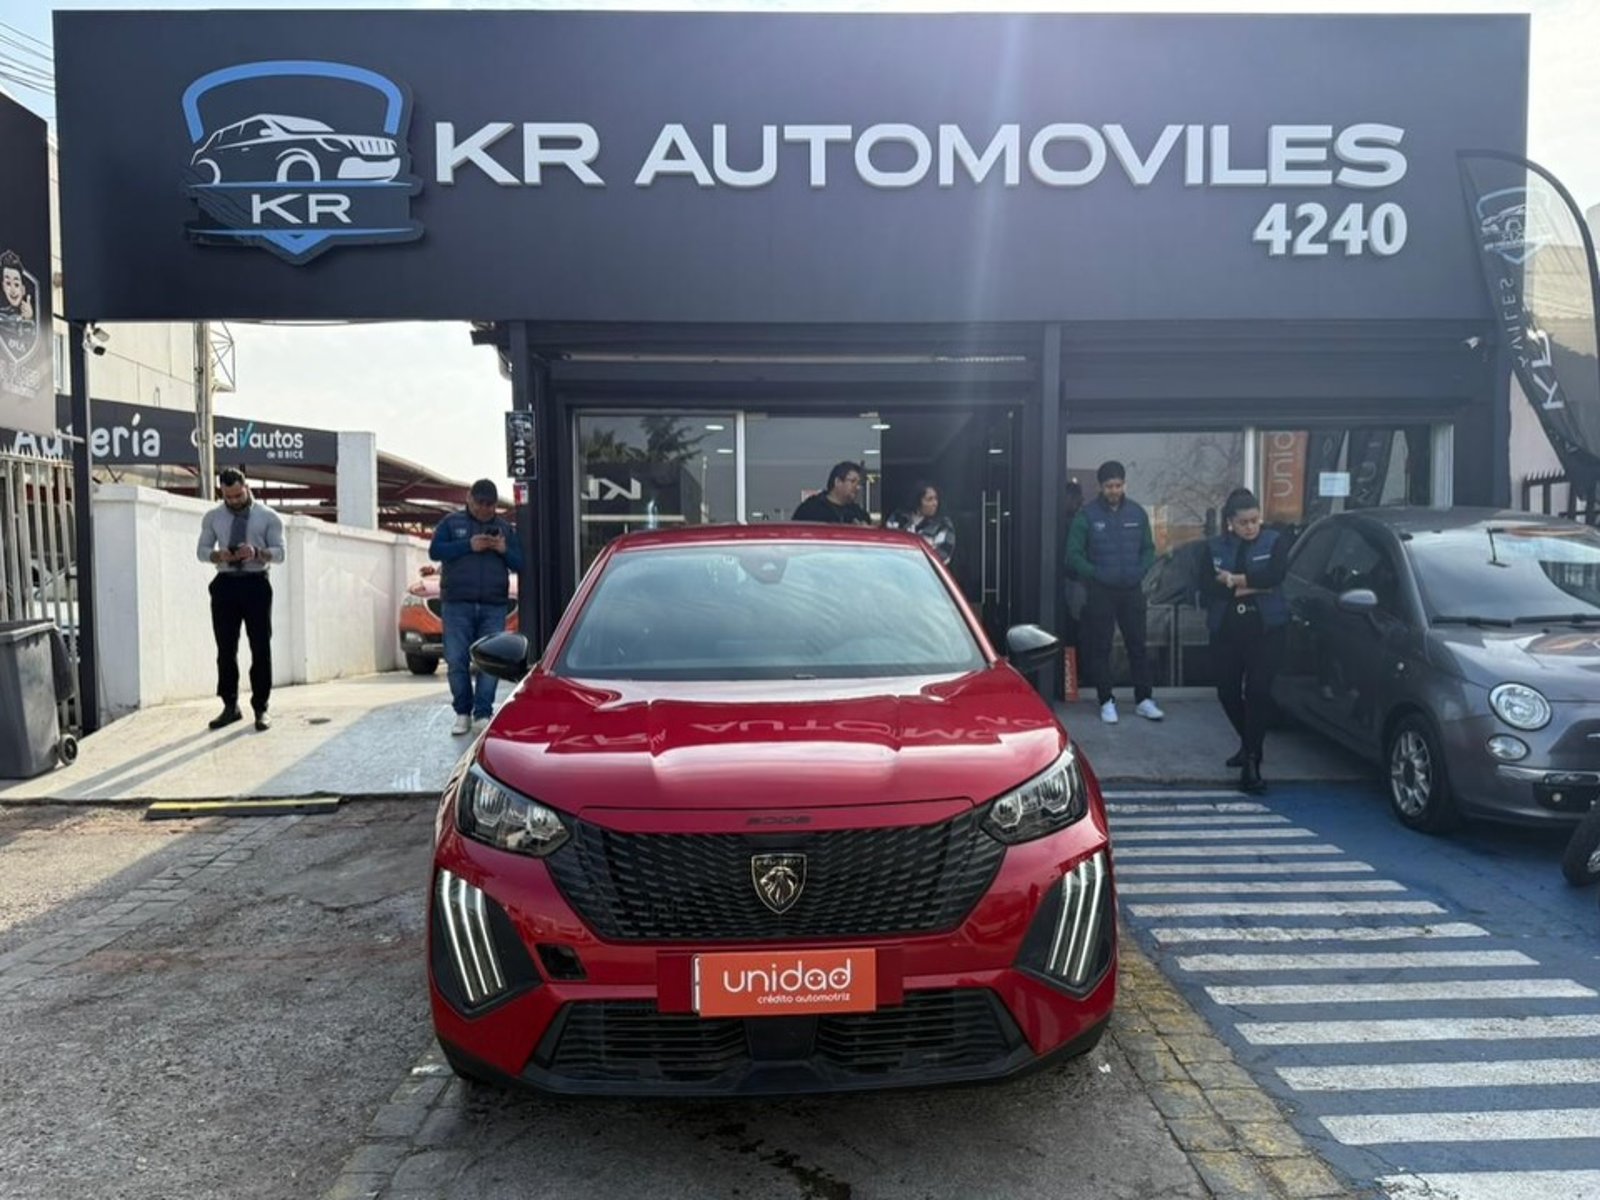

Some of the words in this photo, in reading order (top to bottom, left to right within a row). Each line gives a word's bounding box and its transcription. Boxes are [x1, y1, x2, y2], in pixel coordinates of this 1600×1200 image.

[435, 122, 606, 187] KR
[634, 123, 1409, 188] AUTOMOVILES
[251, 193, 352, 225] KR
[1253, 202, 1409, 257] 4240
[723, 957, 852, 993] unidad
[757, 993, 793, 1005] crédito
[795, 992, 851, 1004] automotriz
